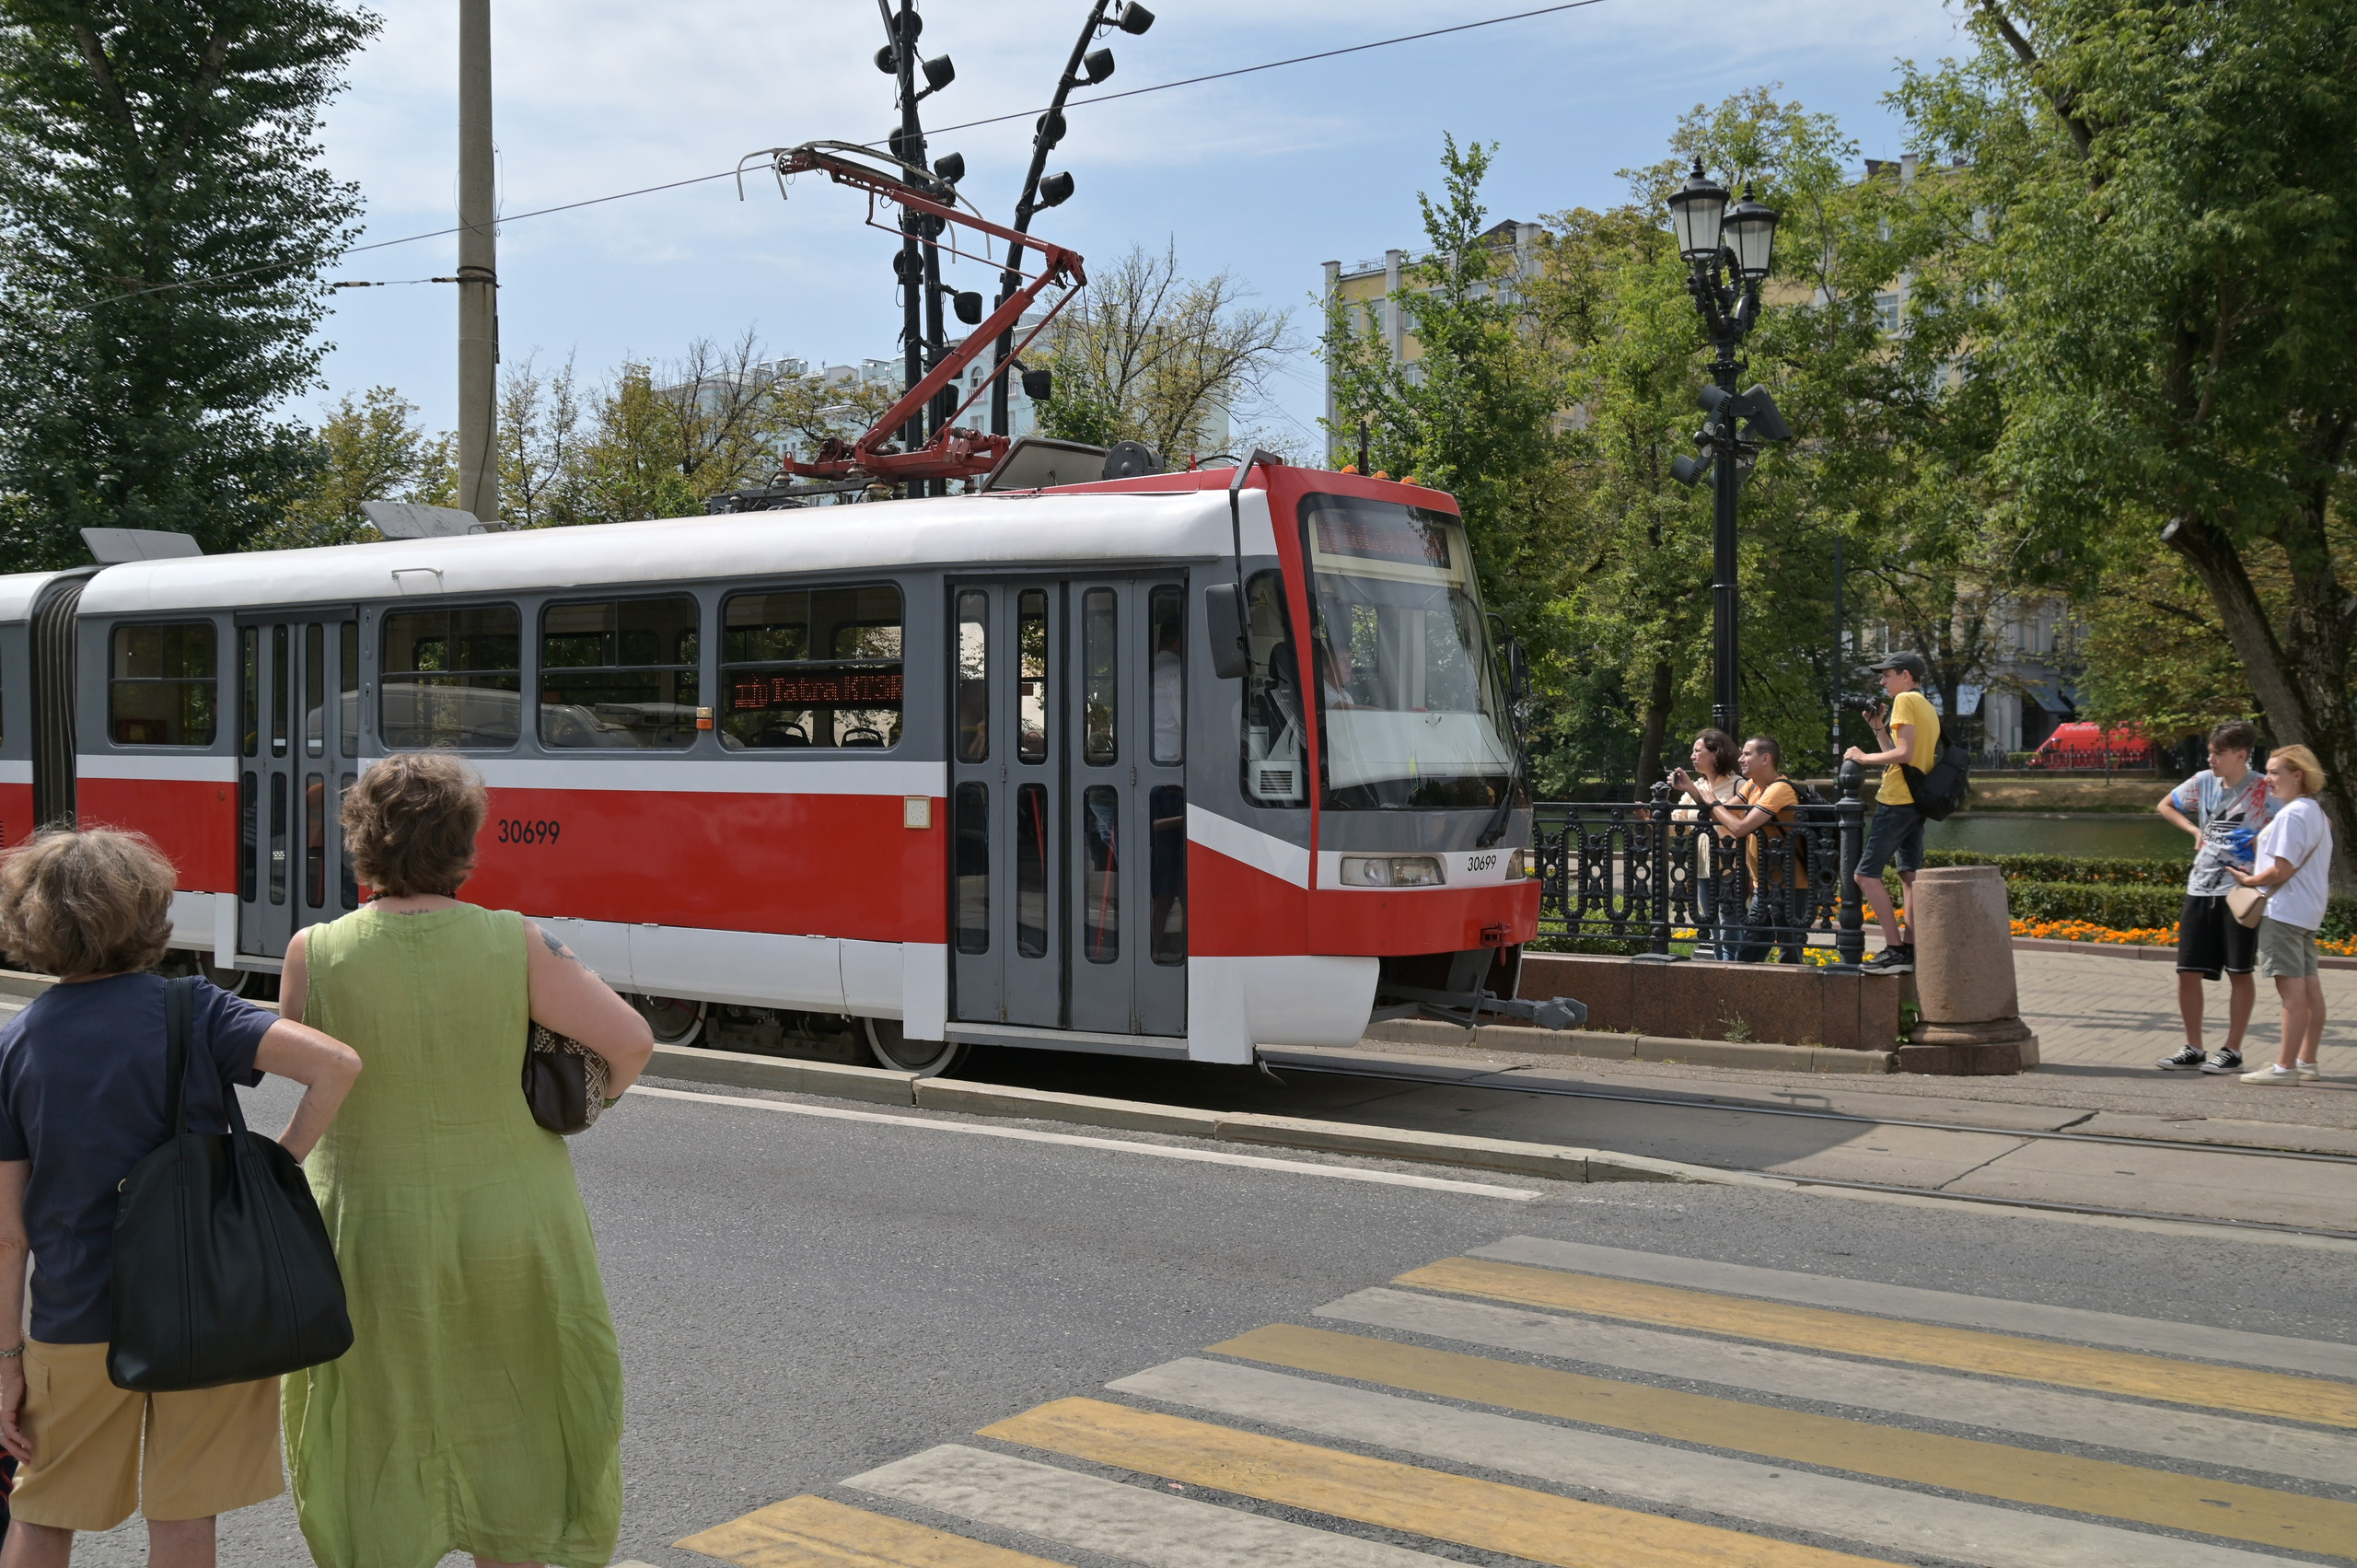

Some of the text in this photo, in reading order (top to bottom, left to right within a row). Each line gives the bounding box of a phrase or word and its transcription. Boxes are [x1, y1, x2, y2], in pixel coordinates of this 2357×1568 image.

[772, 677, 839, 702] Tatra
[498, 819, 560, 845] 30699
[1467, 854, 1497, 872] 30699
